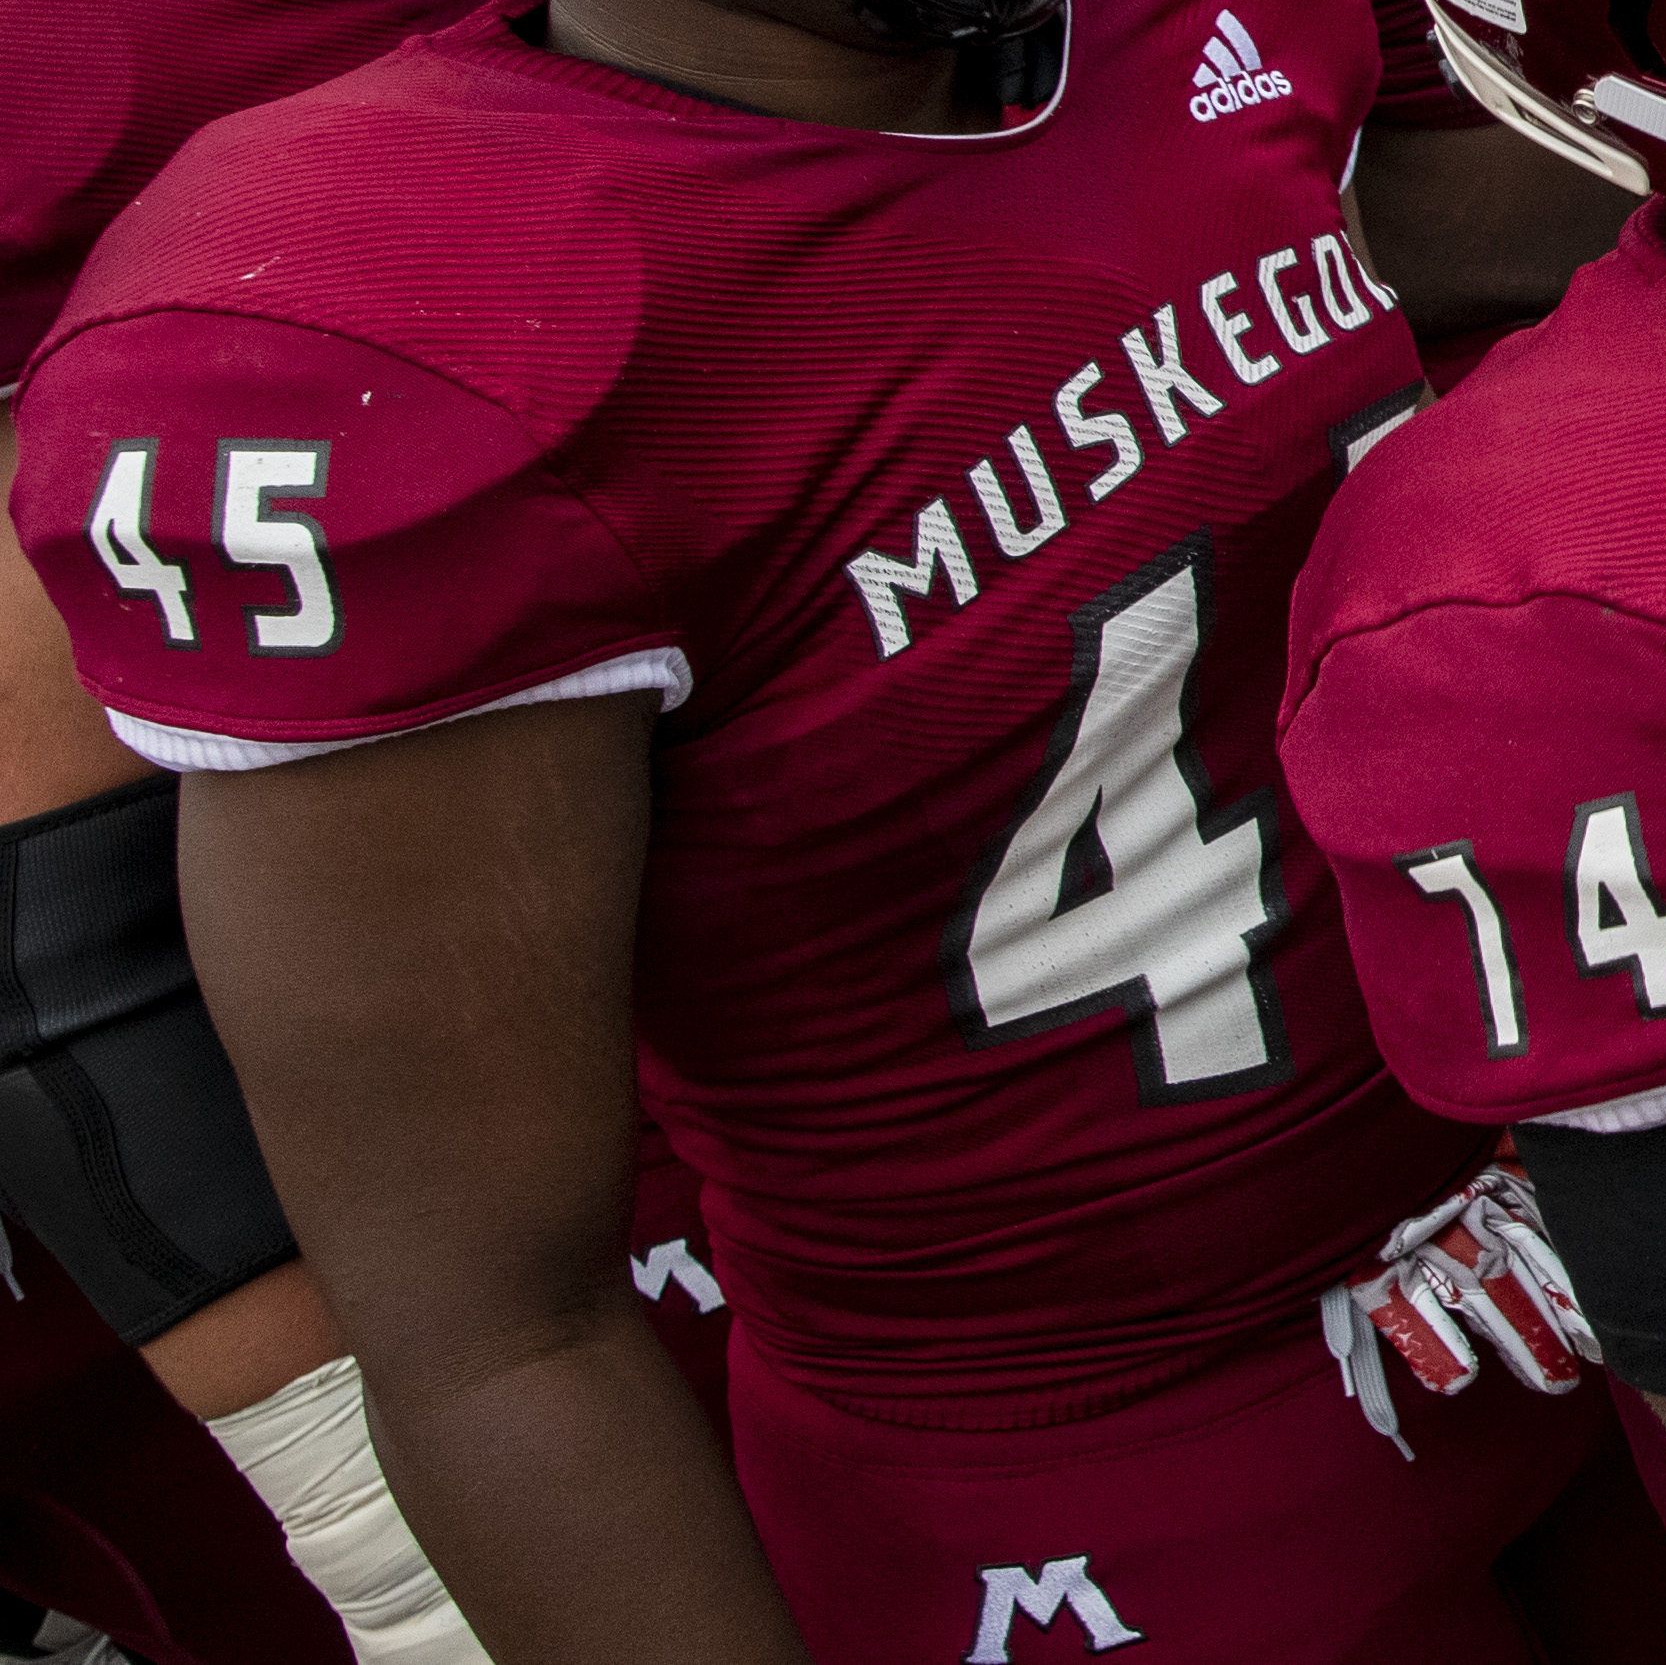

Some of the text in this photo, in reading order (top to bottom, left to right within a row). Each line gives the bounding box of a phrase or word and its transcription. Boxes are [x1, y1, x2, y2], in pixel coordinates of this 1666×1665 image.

[1189, 68, 1294, 123] adidas
[83, 436, 346, 659] 45
[961, 1551, 1148, 1665] M
